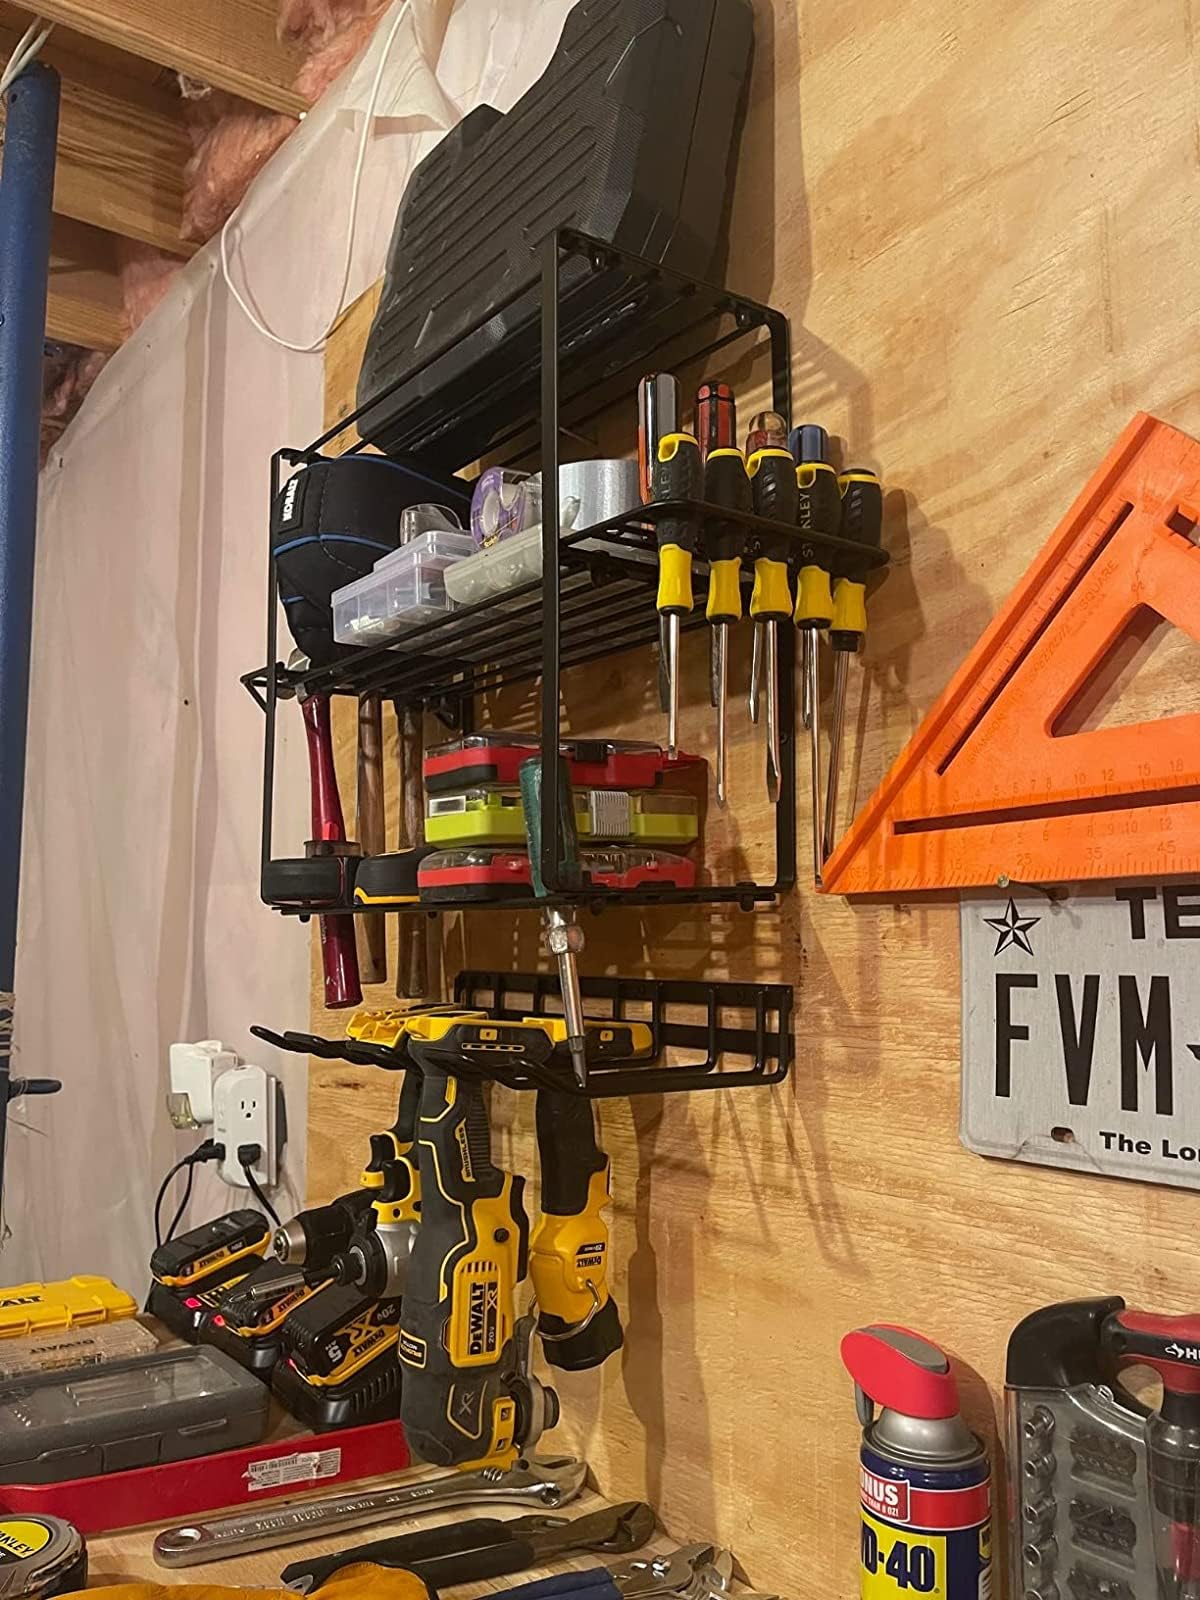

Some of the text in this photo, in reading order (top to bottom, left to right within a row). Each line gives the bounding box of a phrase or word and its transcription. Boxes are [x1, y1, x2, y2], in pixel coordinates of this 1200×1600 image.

[1078, 559, 1120, 610] SQUARE
[1074, 773, 1087, 784] 10
[1102, 769, 1115, 781] 12
[1138, 764, 1151, 776] 15
[1170, 759, 1183, 772] 18
[1160, 819, 1172, 831] 12
[1016, 853, 1032, 865] 25
[1086, 847, 1103, 859] 35
[1157, 840, 1176, 853] 45
[995, 973, 1173, 1115] FVM
[1099, 1131, 1200, 1162] The Lo
[486, 1287, 499, 1312] XR
[470, 1283, 485, 1355] DEWALT
[328, 1345, 343, 1363] 5
[1186, 1347, 1200, 1361] H
[458, 1391, 476, 1417] XR
[861, 1520, 936, 1593] D-40
